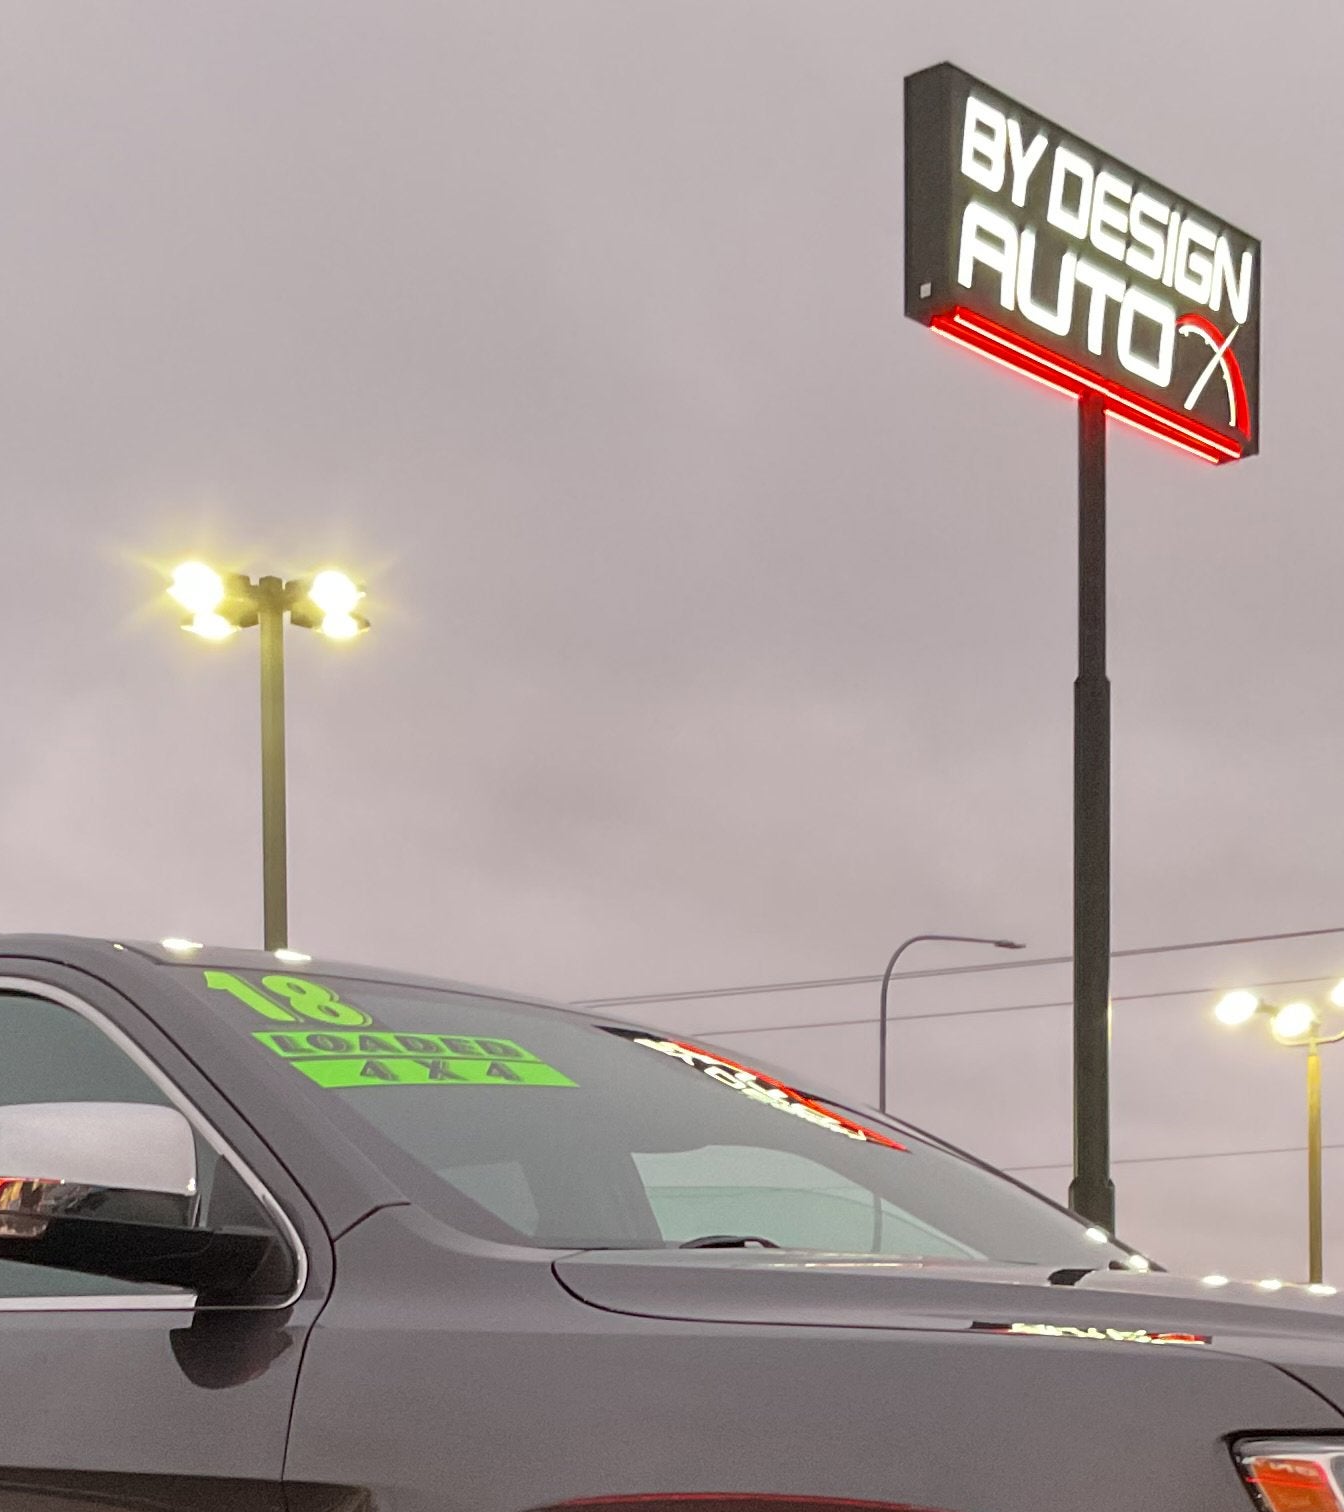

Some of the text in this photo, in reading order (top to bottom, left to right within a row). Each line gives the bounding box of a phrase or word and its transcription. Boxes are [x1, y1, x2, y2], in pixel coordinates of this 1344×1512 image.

[961, 96, 1253, 324] BY DESIGN
[958, 201, 1176, 388] AUTO
[203, 971, 373, 1027] 18
[269, 1033, 524, 1059] LOADED
